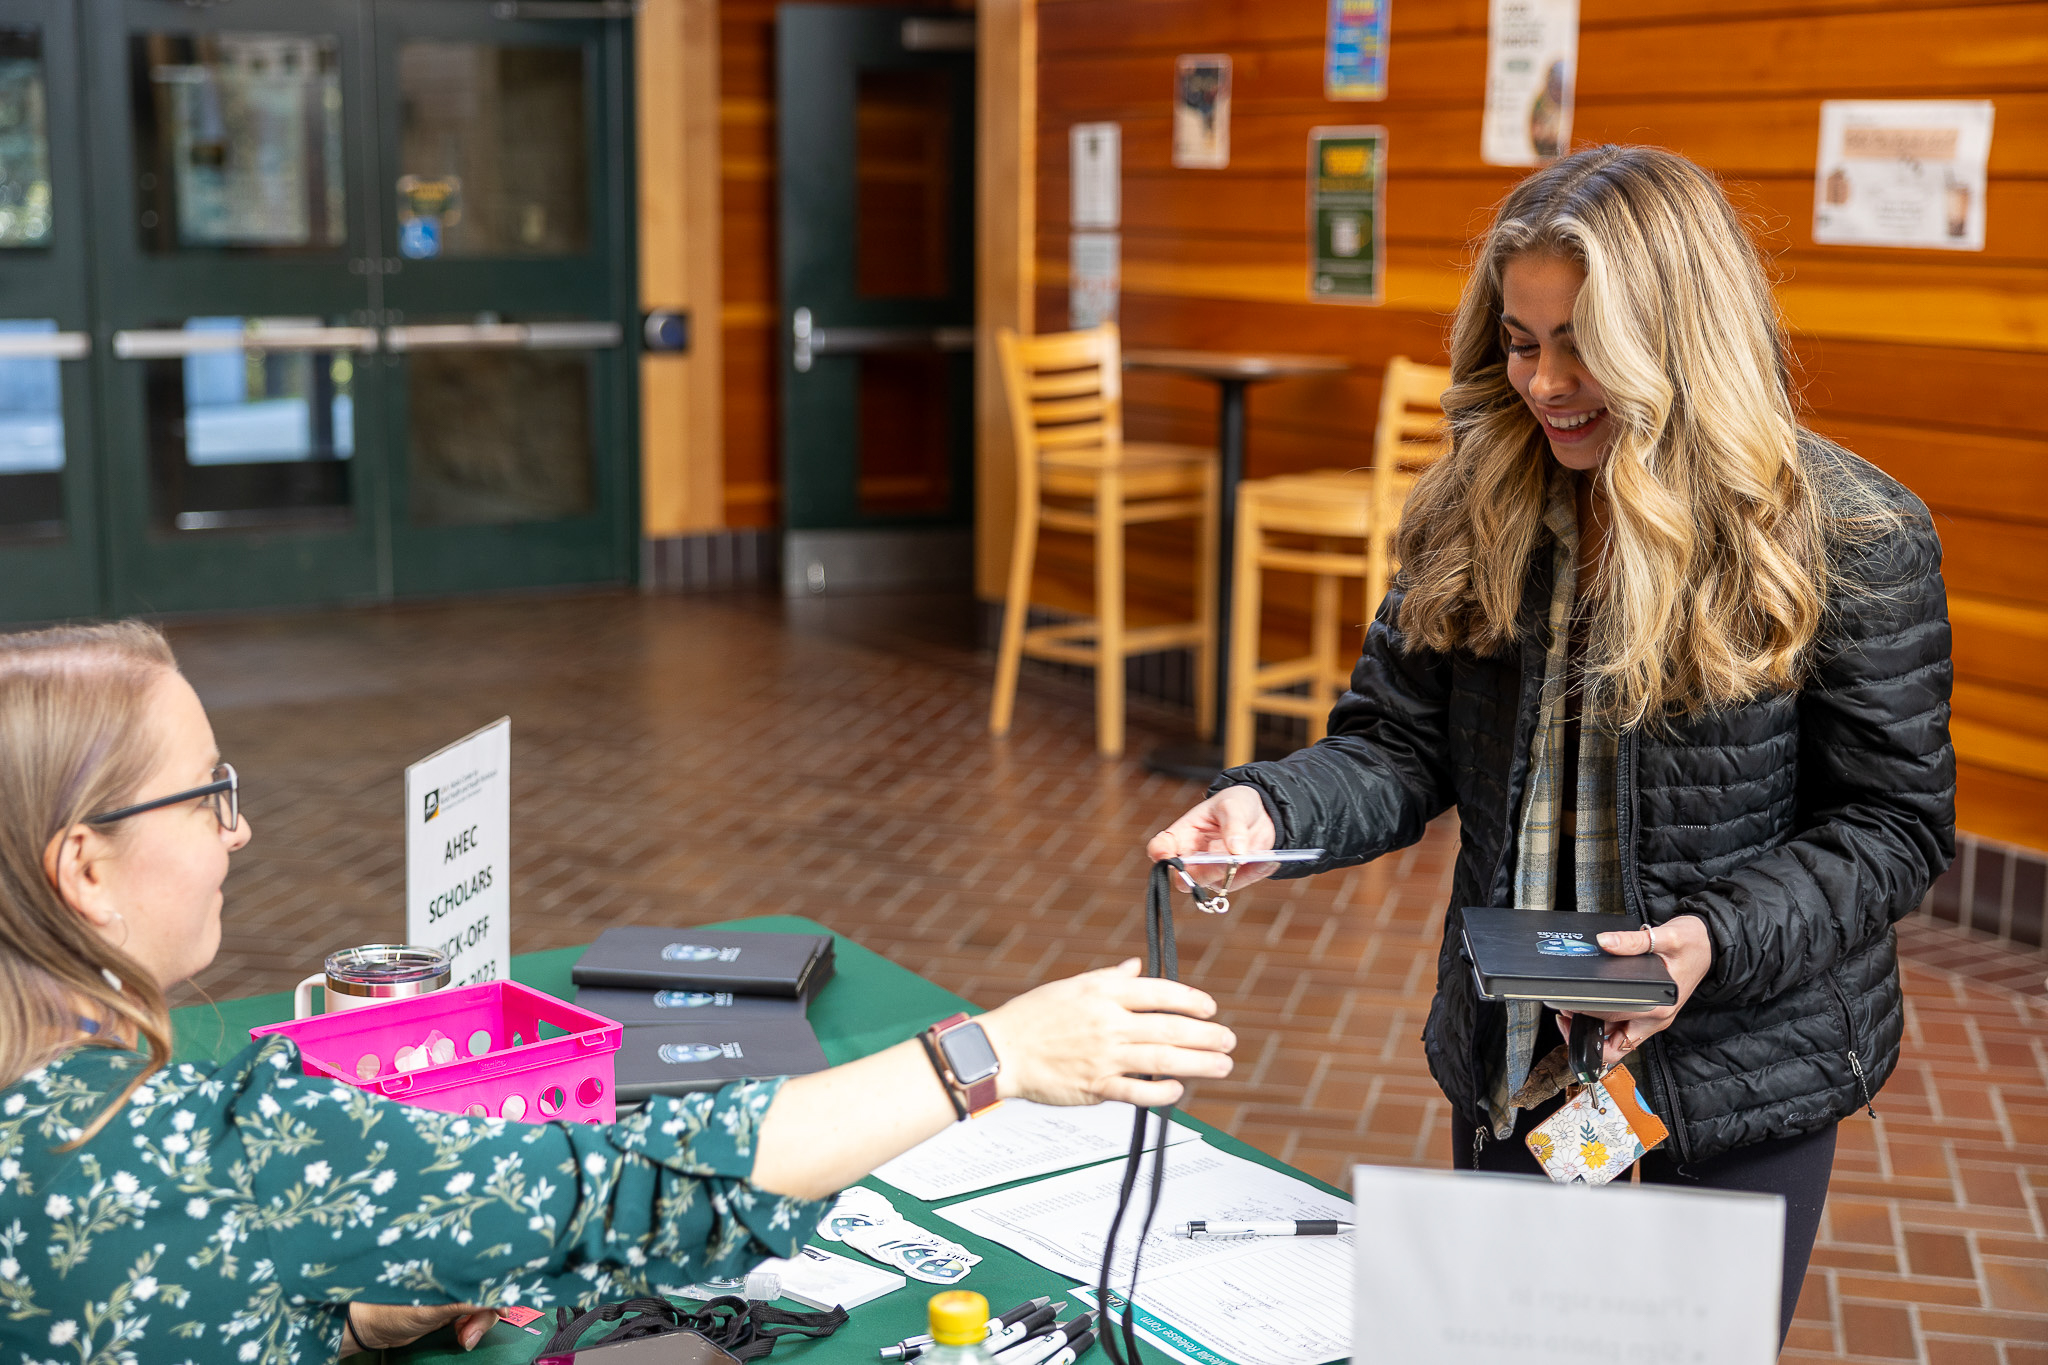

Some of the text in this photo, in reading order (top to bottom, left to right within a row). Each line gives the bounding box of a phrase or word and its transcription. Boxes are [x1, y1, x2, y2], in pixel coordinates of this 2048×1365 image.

[444, 825, 478, 864] AHEC
[429, 865, 493, 924] SCHOLARS
[440, 915, 489, 960] CK-OFF
[1139, 1315, 1166, 1332] Form
[1163, 1329, 1201, 1353] Release
